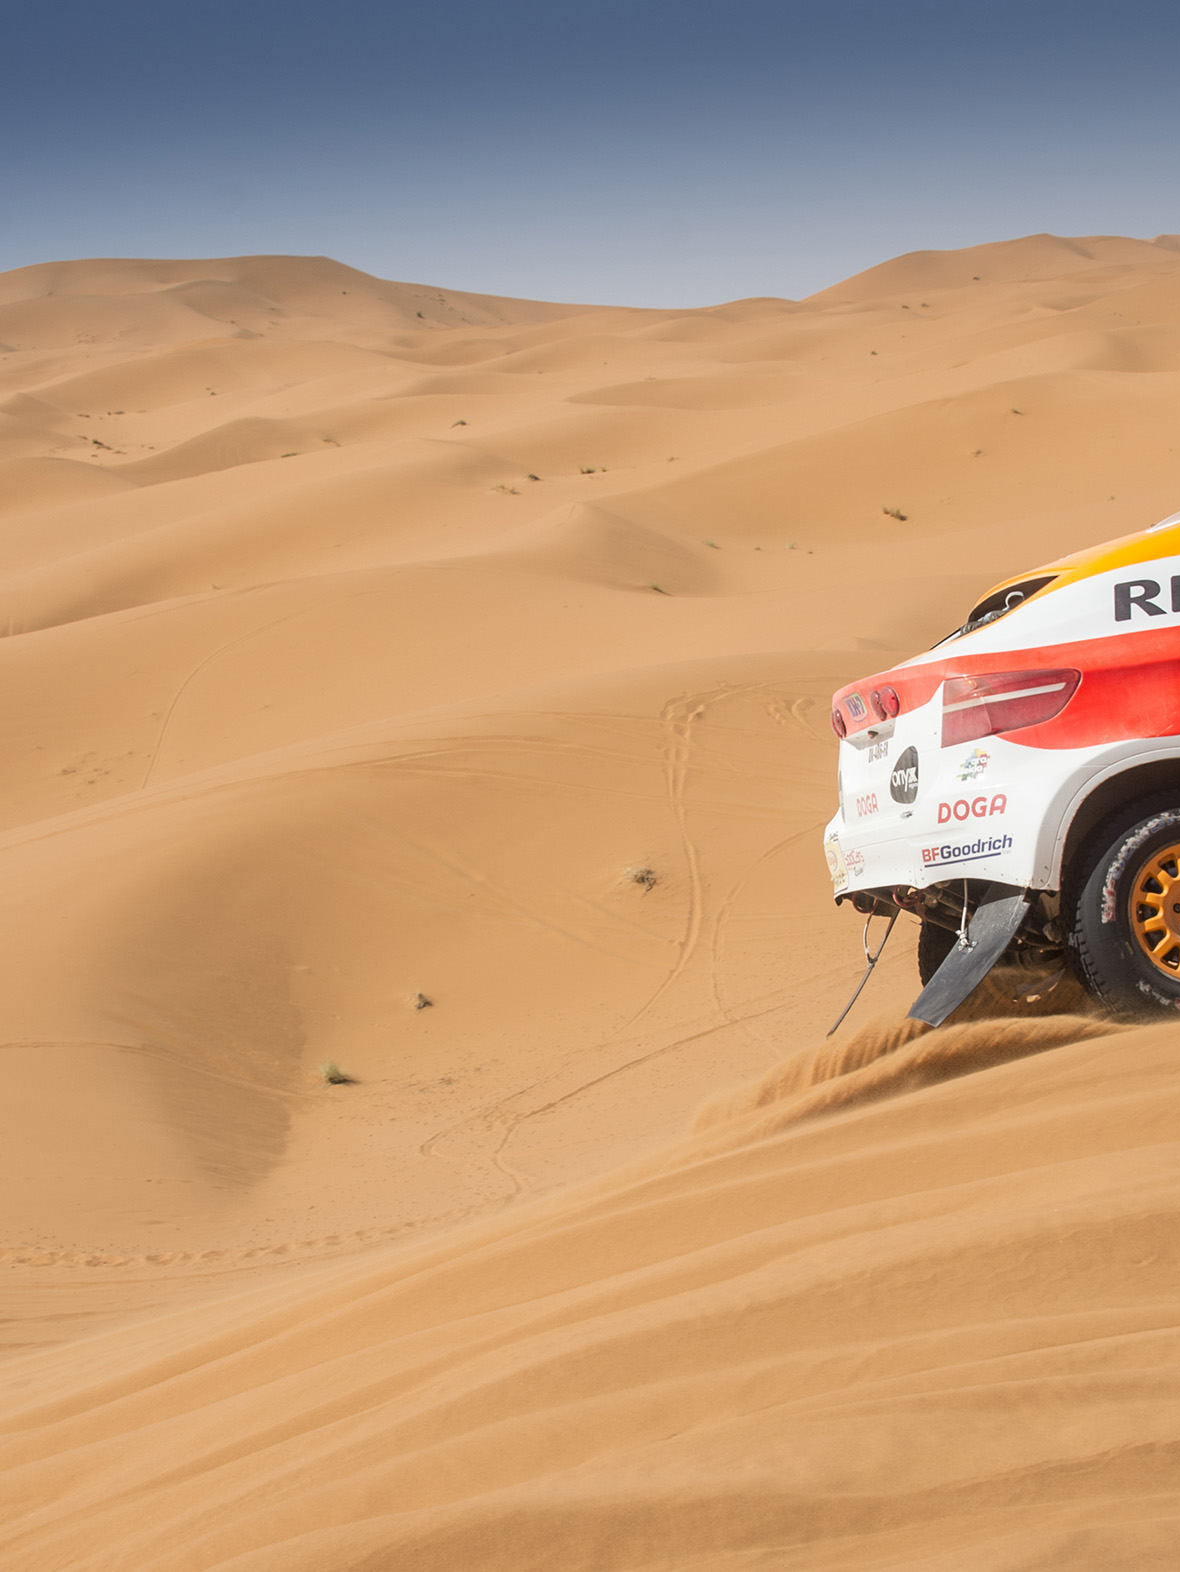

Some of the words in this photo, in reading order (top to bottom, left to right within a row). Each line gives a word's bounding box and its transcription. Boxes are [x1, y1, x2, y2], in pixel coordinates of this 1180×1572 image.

[856, 793, 879, 817] DOGA
[937, 793, 1007, 824] DOGA
[921, 835, 1013, 863] BFGoodrich
